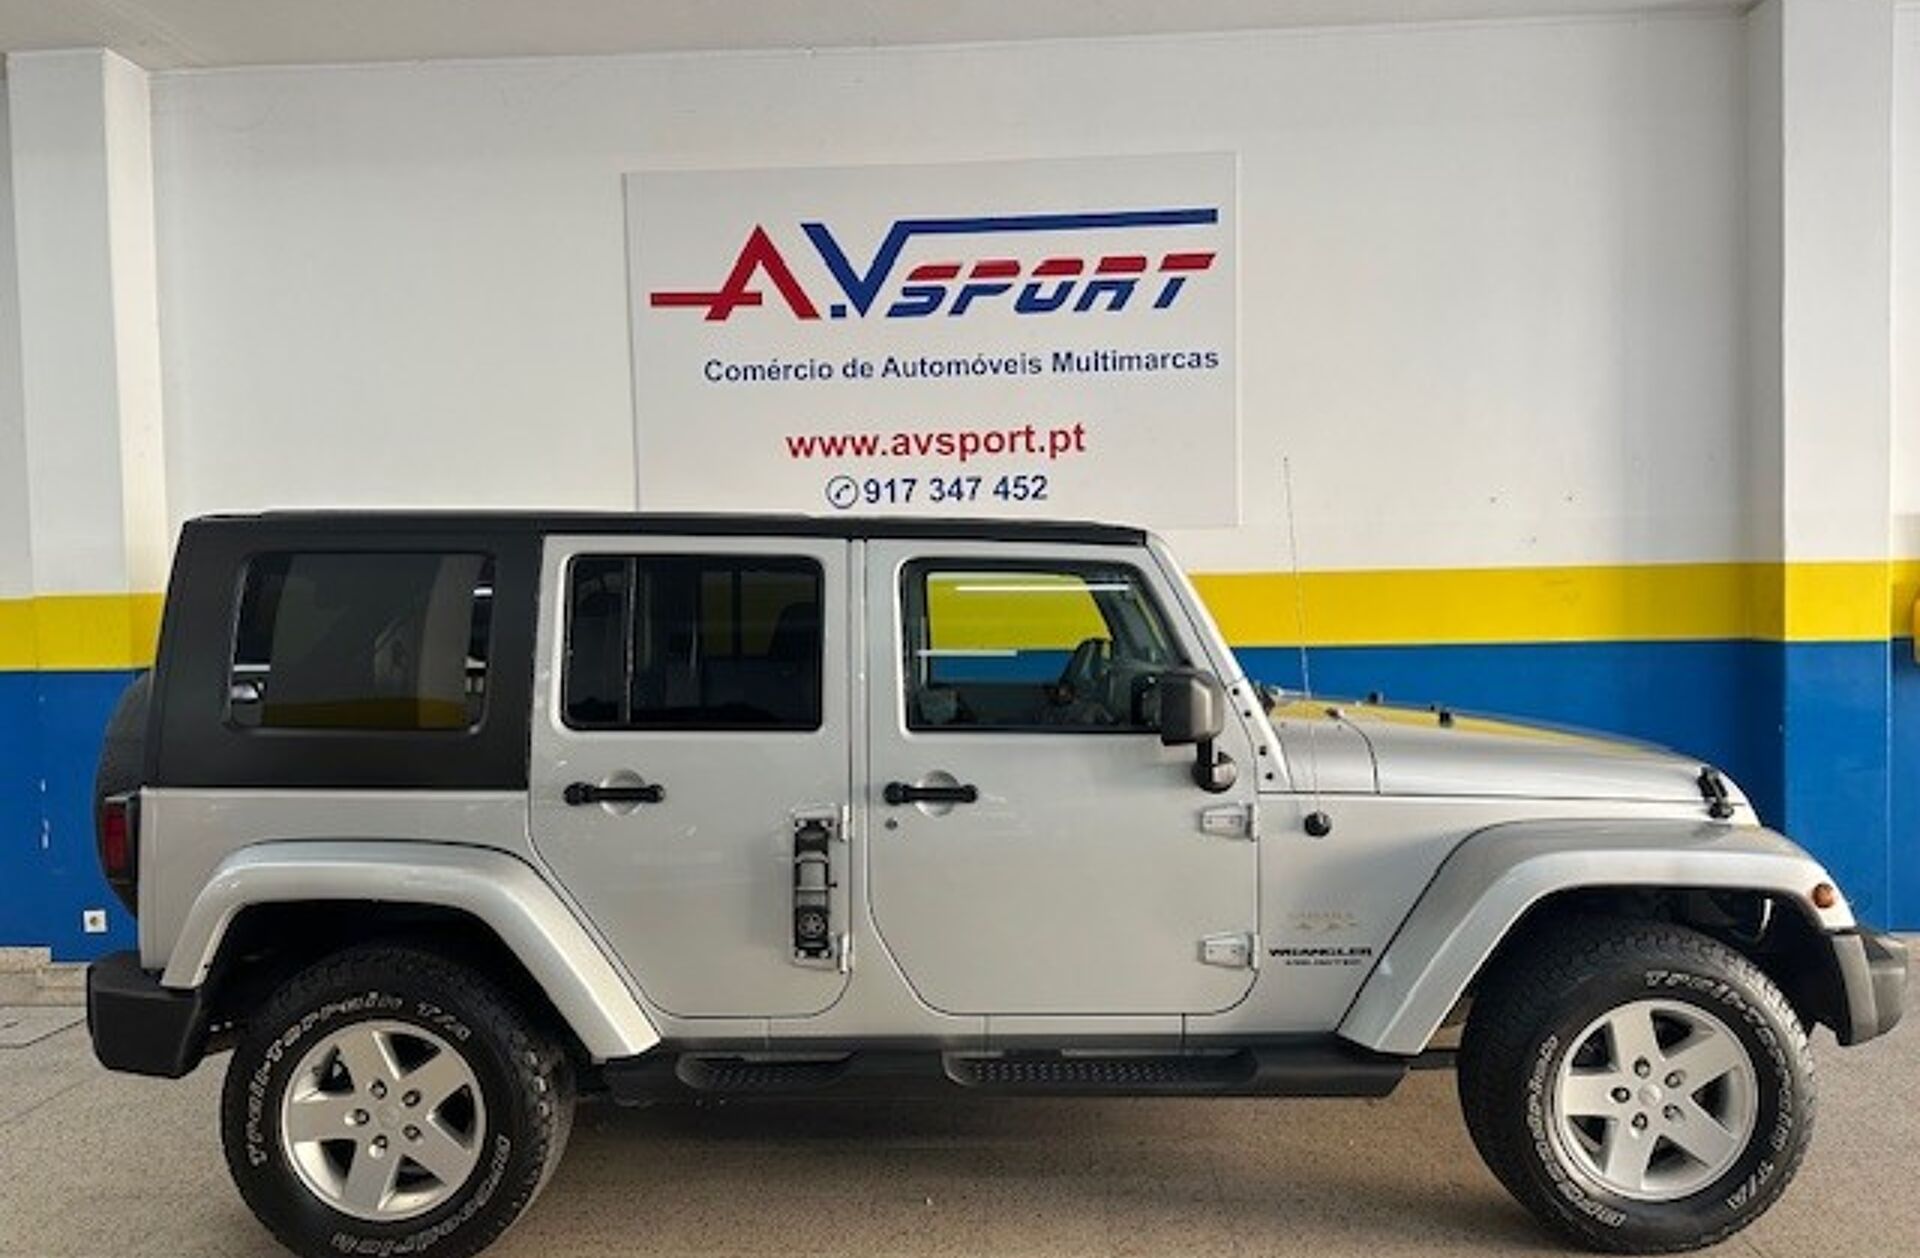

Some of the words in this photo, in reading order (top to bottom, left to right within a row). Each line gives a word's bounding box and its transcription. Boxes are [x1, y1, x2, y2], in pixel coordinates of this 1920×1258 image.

[704, 358, 834, 382] Comércio
[842, 357, 874, 379] de
[881, 353, 1043, 379] Automóveis
[1052, 349, 1219, 373] Multimarcas
[786, 423, 1086, 462] www.avsport.pt
[863, 478, 918, 504] 917
[929, 476, 982, 502] 347
[993, 474, 1048, 501] 452
